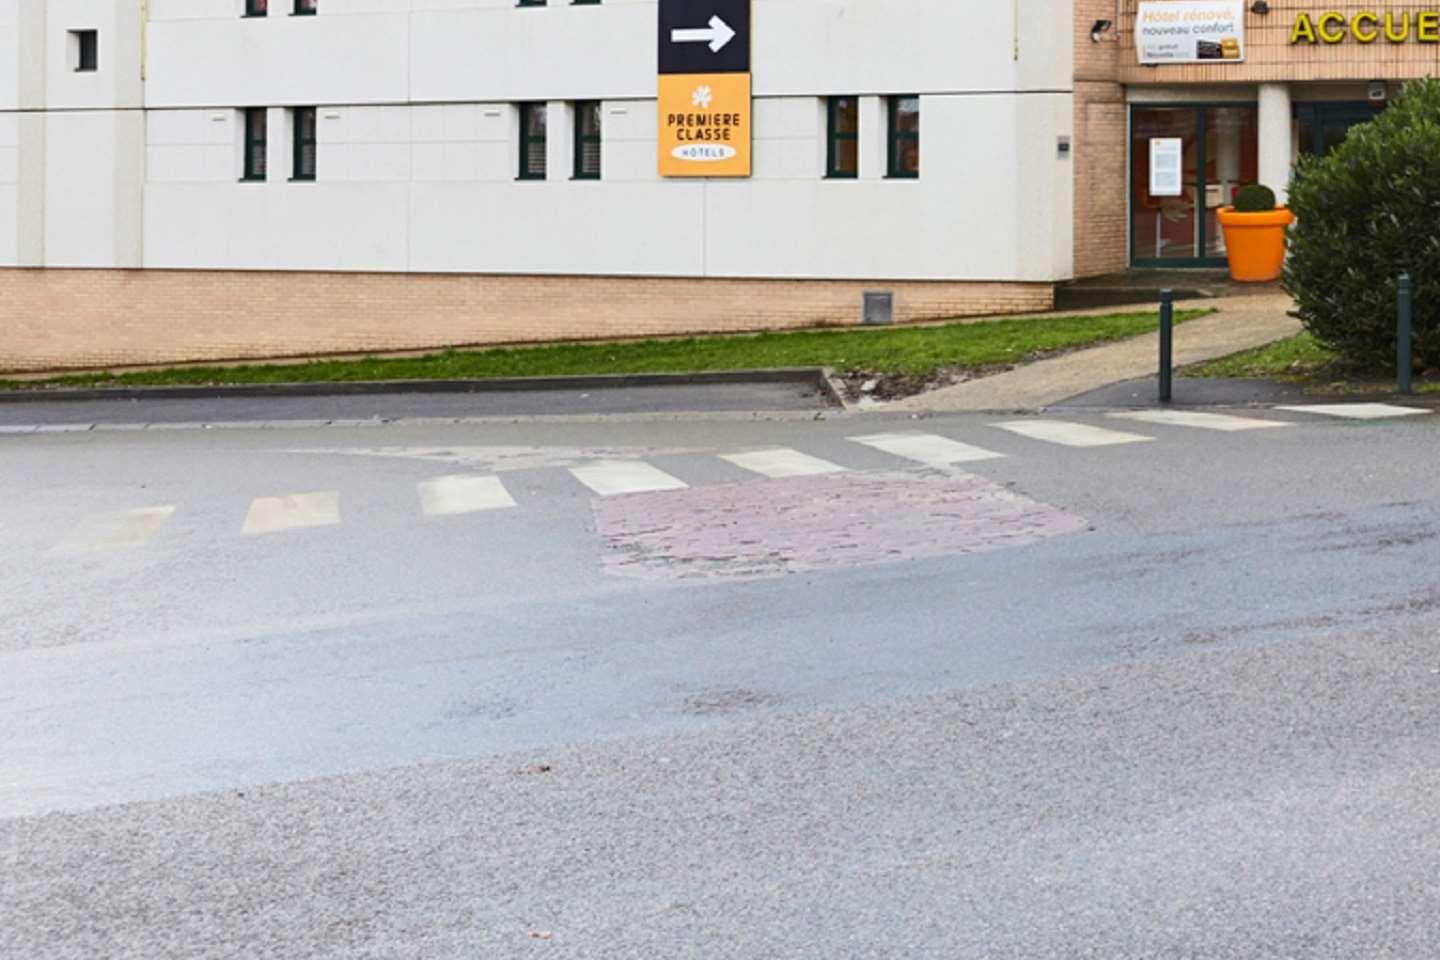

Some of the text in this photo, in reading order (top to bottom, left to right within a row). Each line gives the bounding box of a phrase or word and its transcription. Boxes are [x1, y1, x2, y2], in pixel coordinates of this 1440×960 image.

[1142, 21, 1234, 36] nouveau confort
[667, 112, 741, 127] PREMIERE
[676, 128, 731, 141] CLASSE
[682, 146, 725, 158] HOTELS
